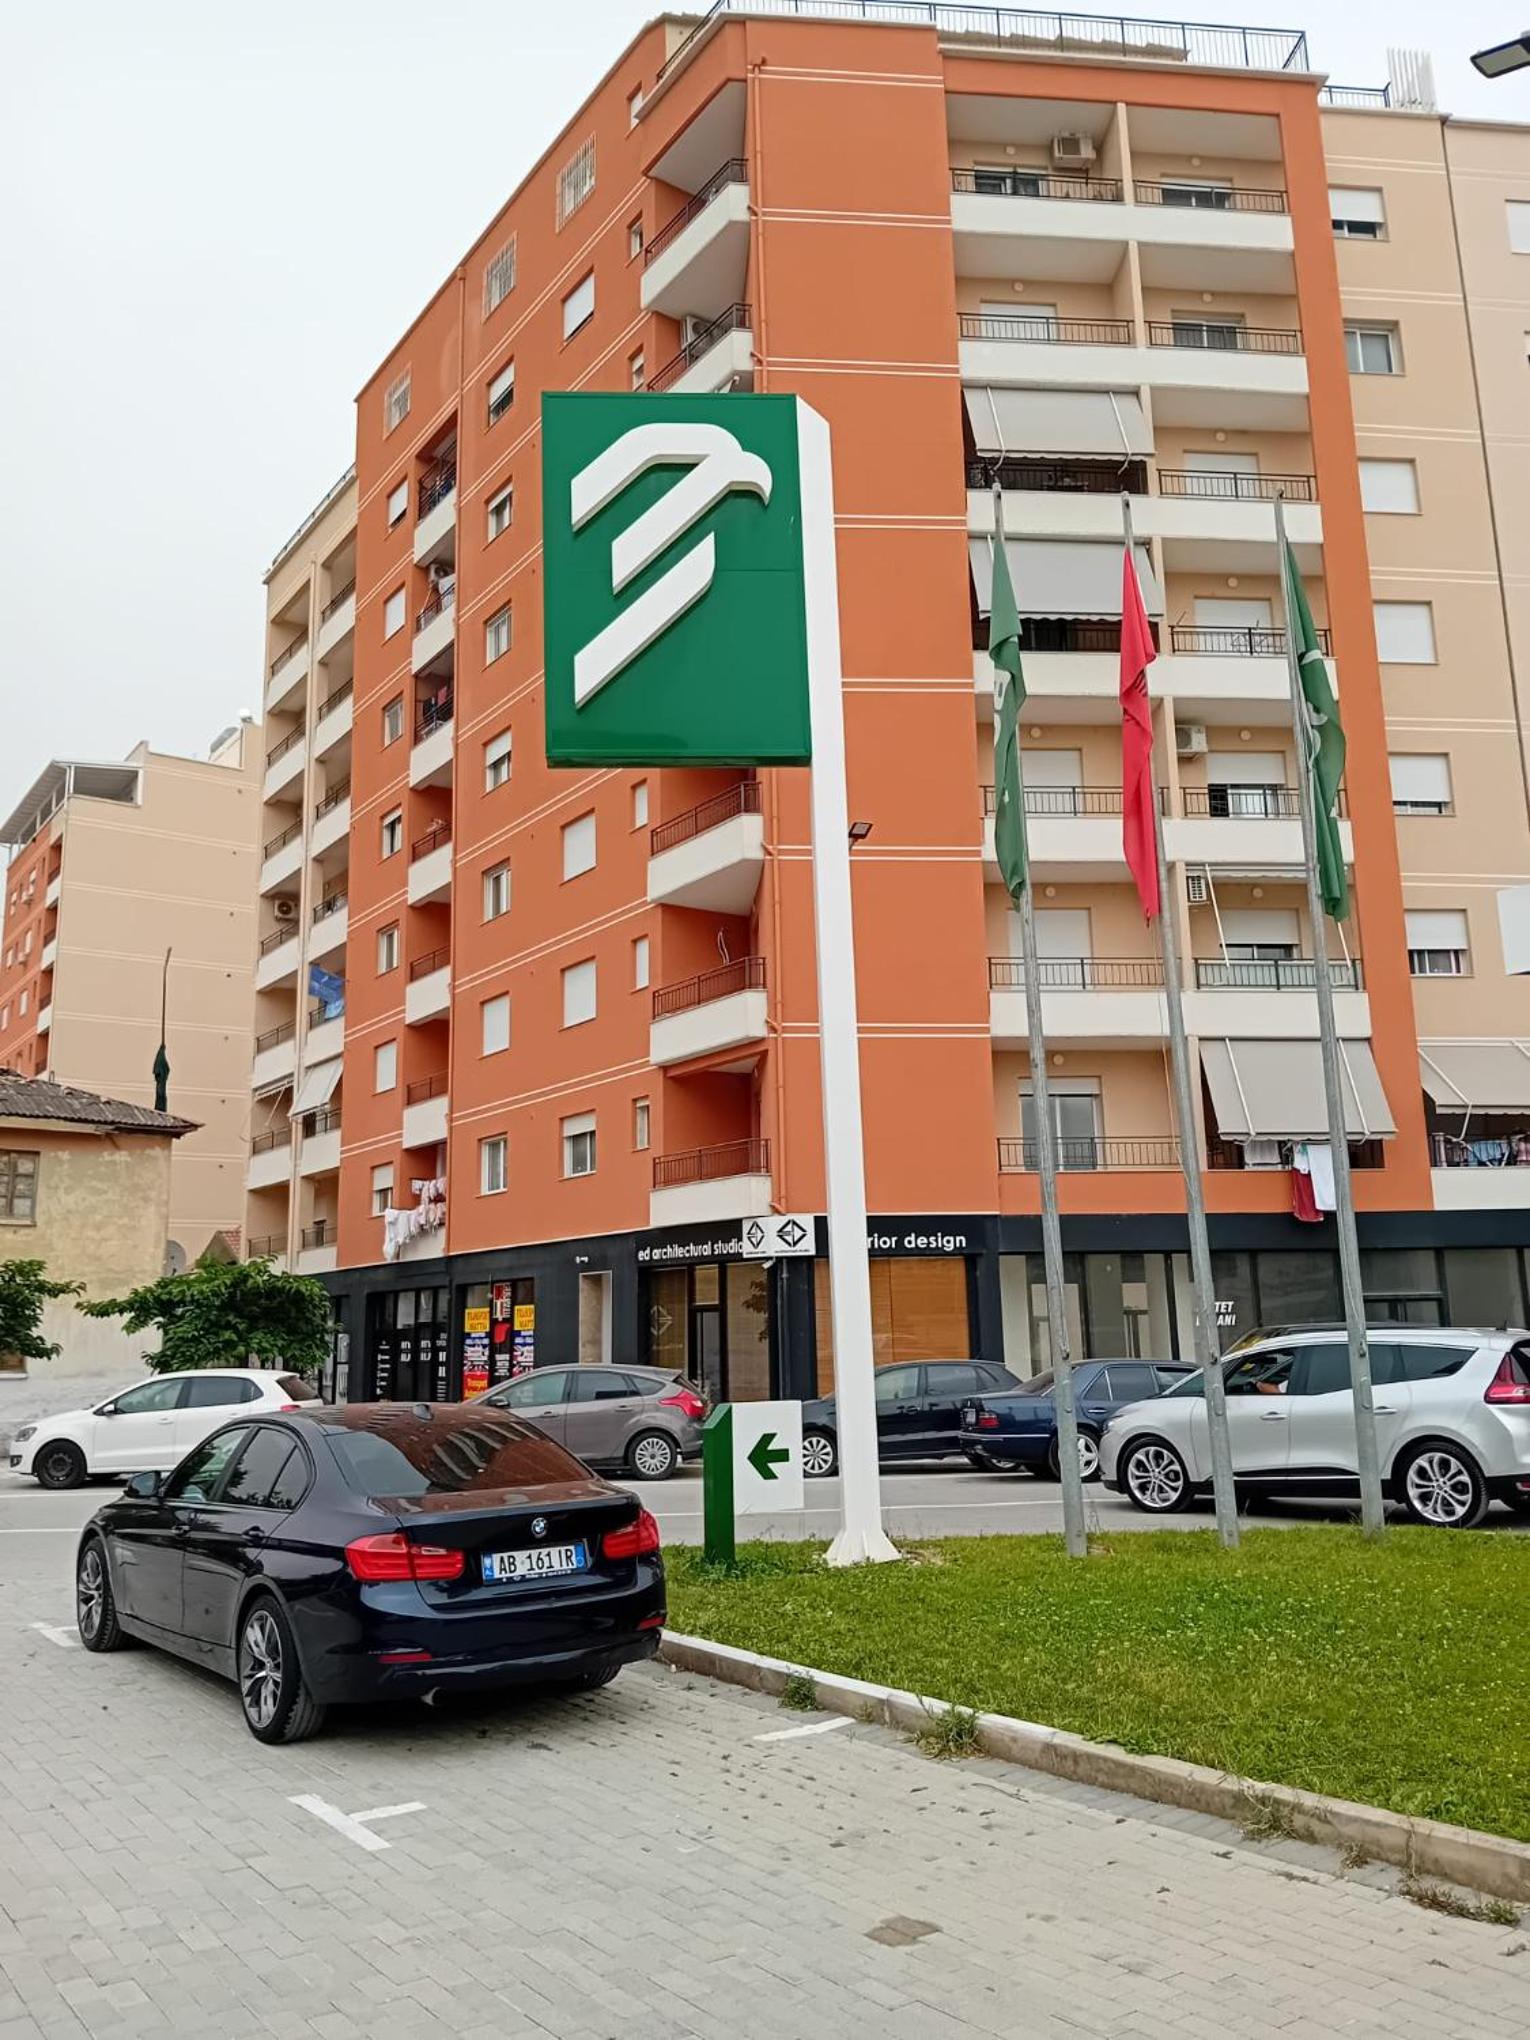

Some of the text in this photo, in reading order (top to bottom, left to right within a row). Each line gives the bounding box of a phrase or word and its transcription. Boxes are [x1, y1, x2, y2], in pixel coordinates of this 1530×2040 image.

[868, 1232, 966, 1251] rior design
[638, 1247, 651, 1261] ed
[652, 1242, 711, 1259] architectural
[1214, 1301, 1234, 1313] TET
[499, 1548, 574, 1574] AB 161 IR
